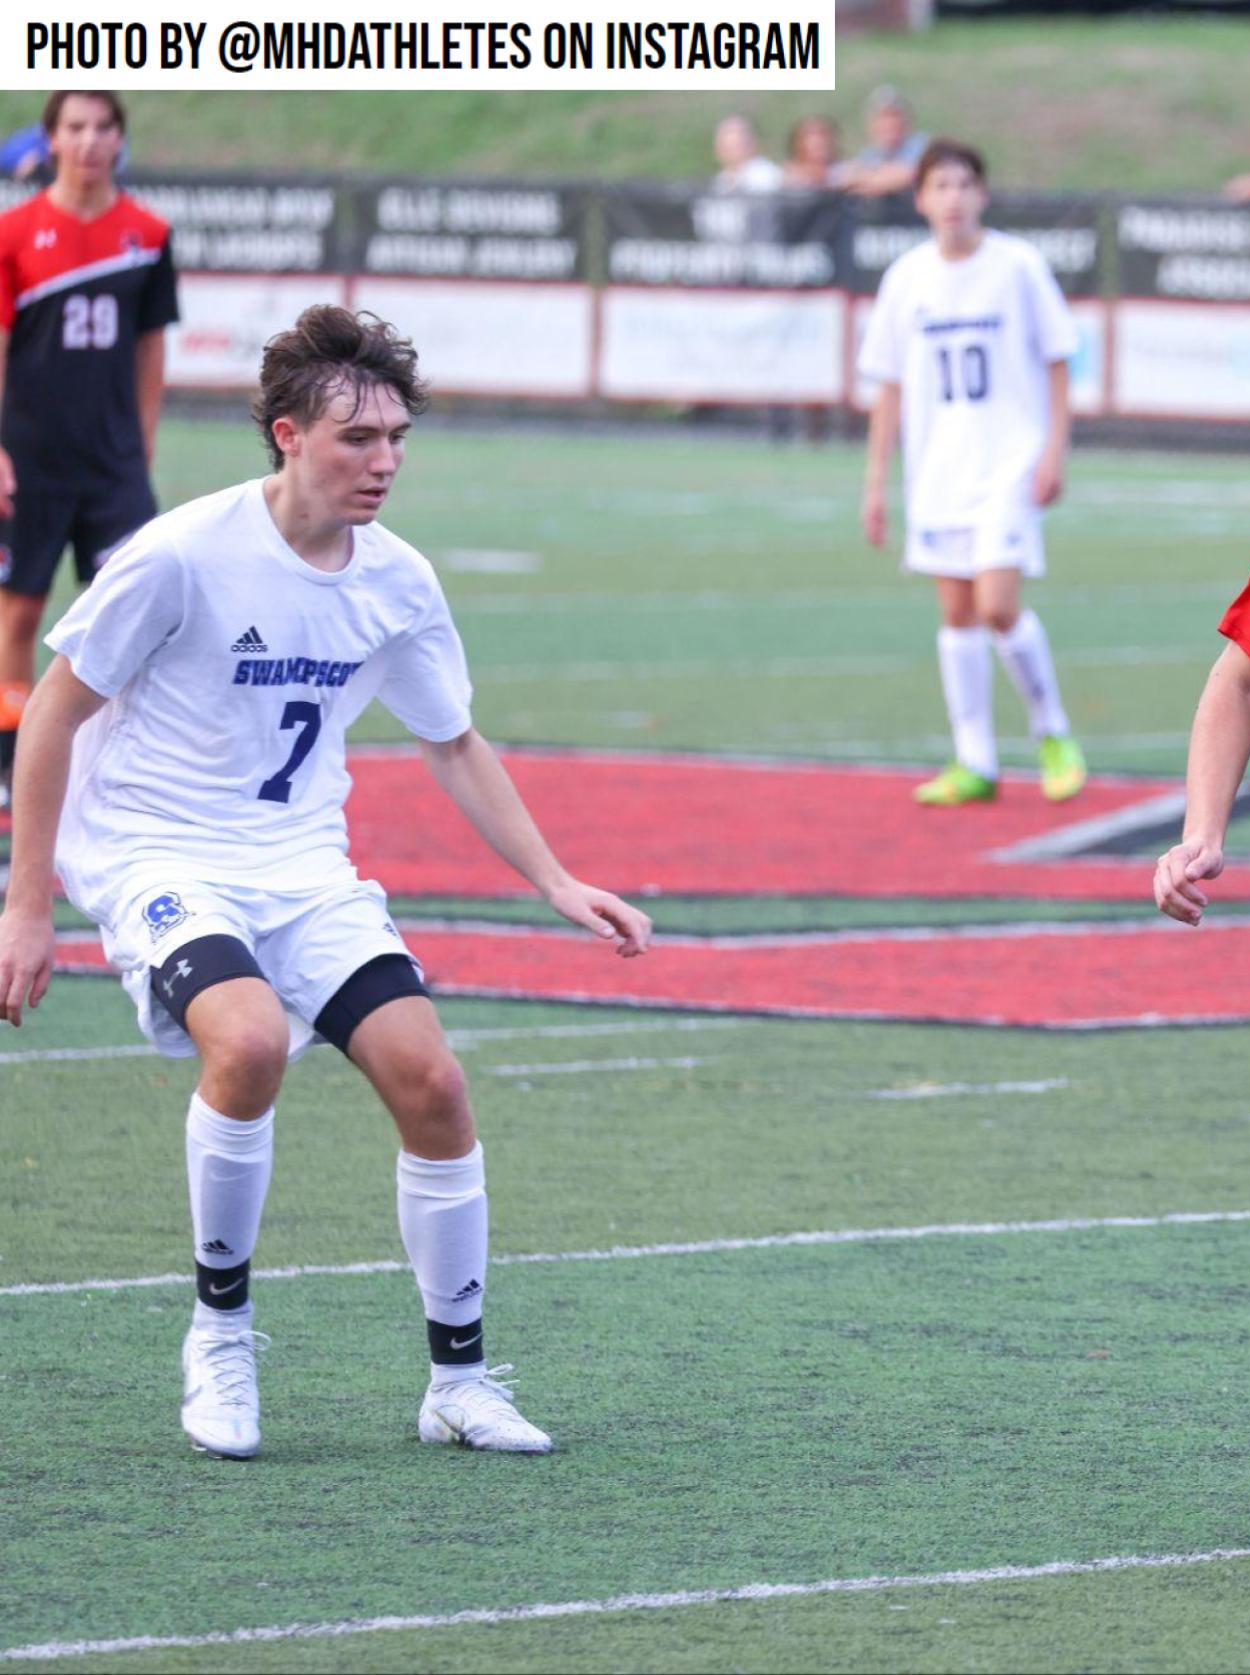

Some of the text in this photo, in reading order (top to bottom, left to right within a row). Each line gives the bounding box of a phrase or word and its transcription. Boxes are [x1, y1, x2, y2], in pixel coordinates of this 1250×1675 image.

[62, 294, 118, 349] 29
[938, 345, 988, 402] 10
[257, 700, 322, 804] 7
